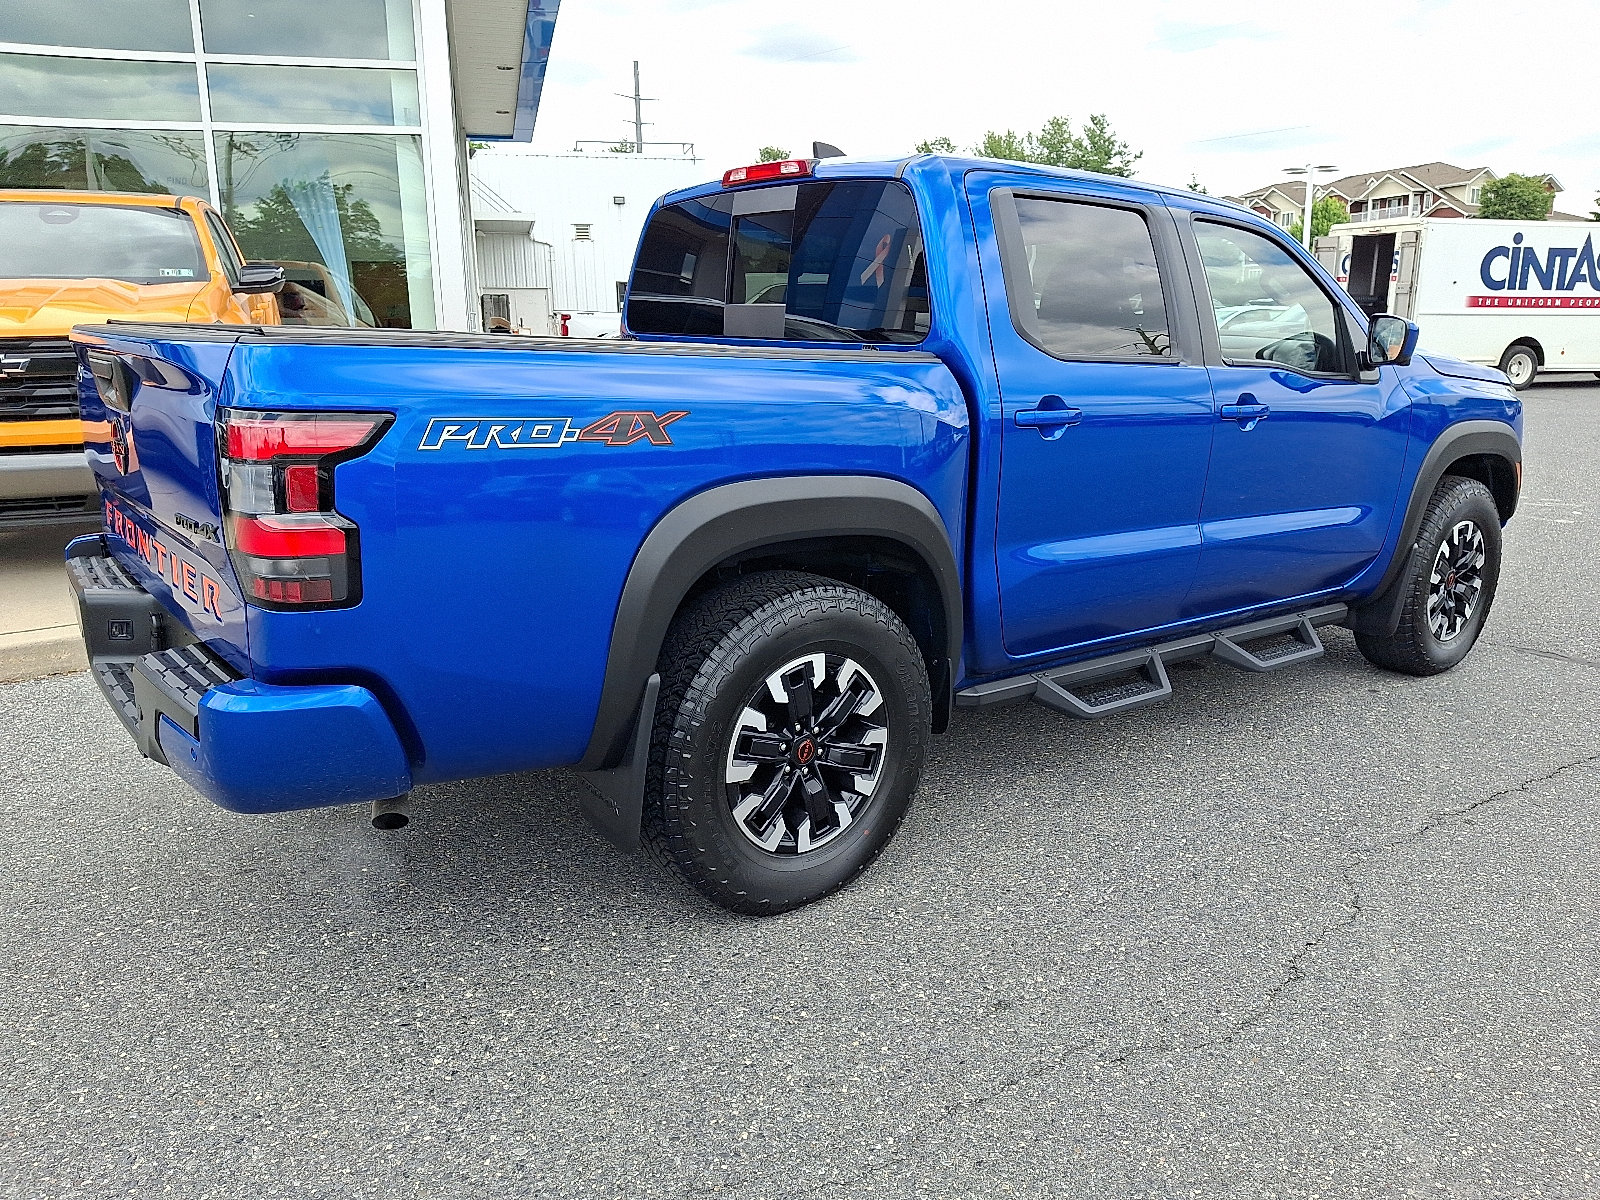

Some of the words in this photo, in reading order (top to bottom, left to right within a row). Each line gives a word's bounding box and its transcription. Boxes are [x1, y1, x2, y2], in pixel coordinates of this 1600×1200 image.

[1480, 231, 1600, 291] CINTA
[1478, 298, 1500, 307] THE
[1507, 298, 1561, 307] UNIFORM
[104, 498, 224, 625] FRONTIER
